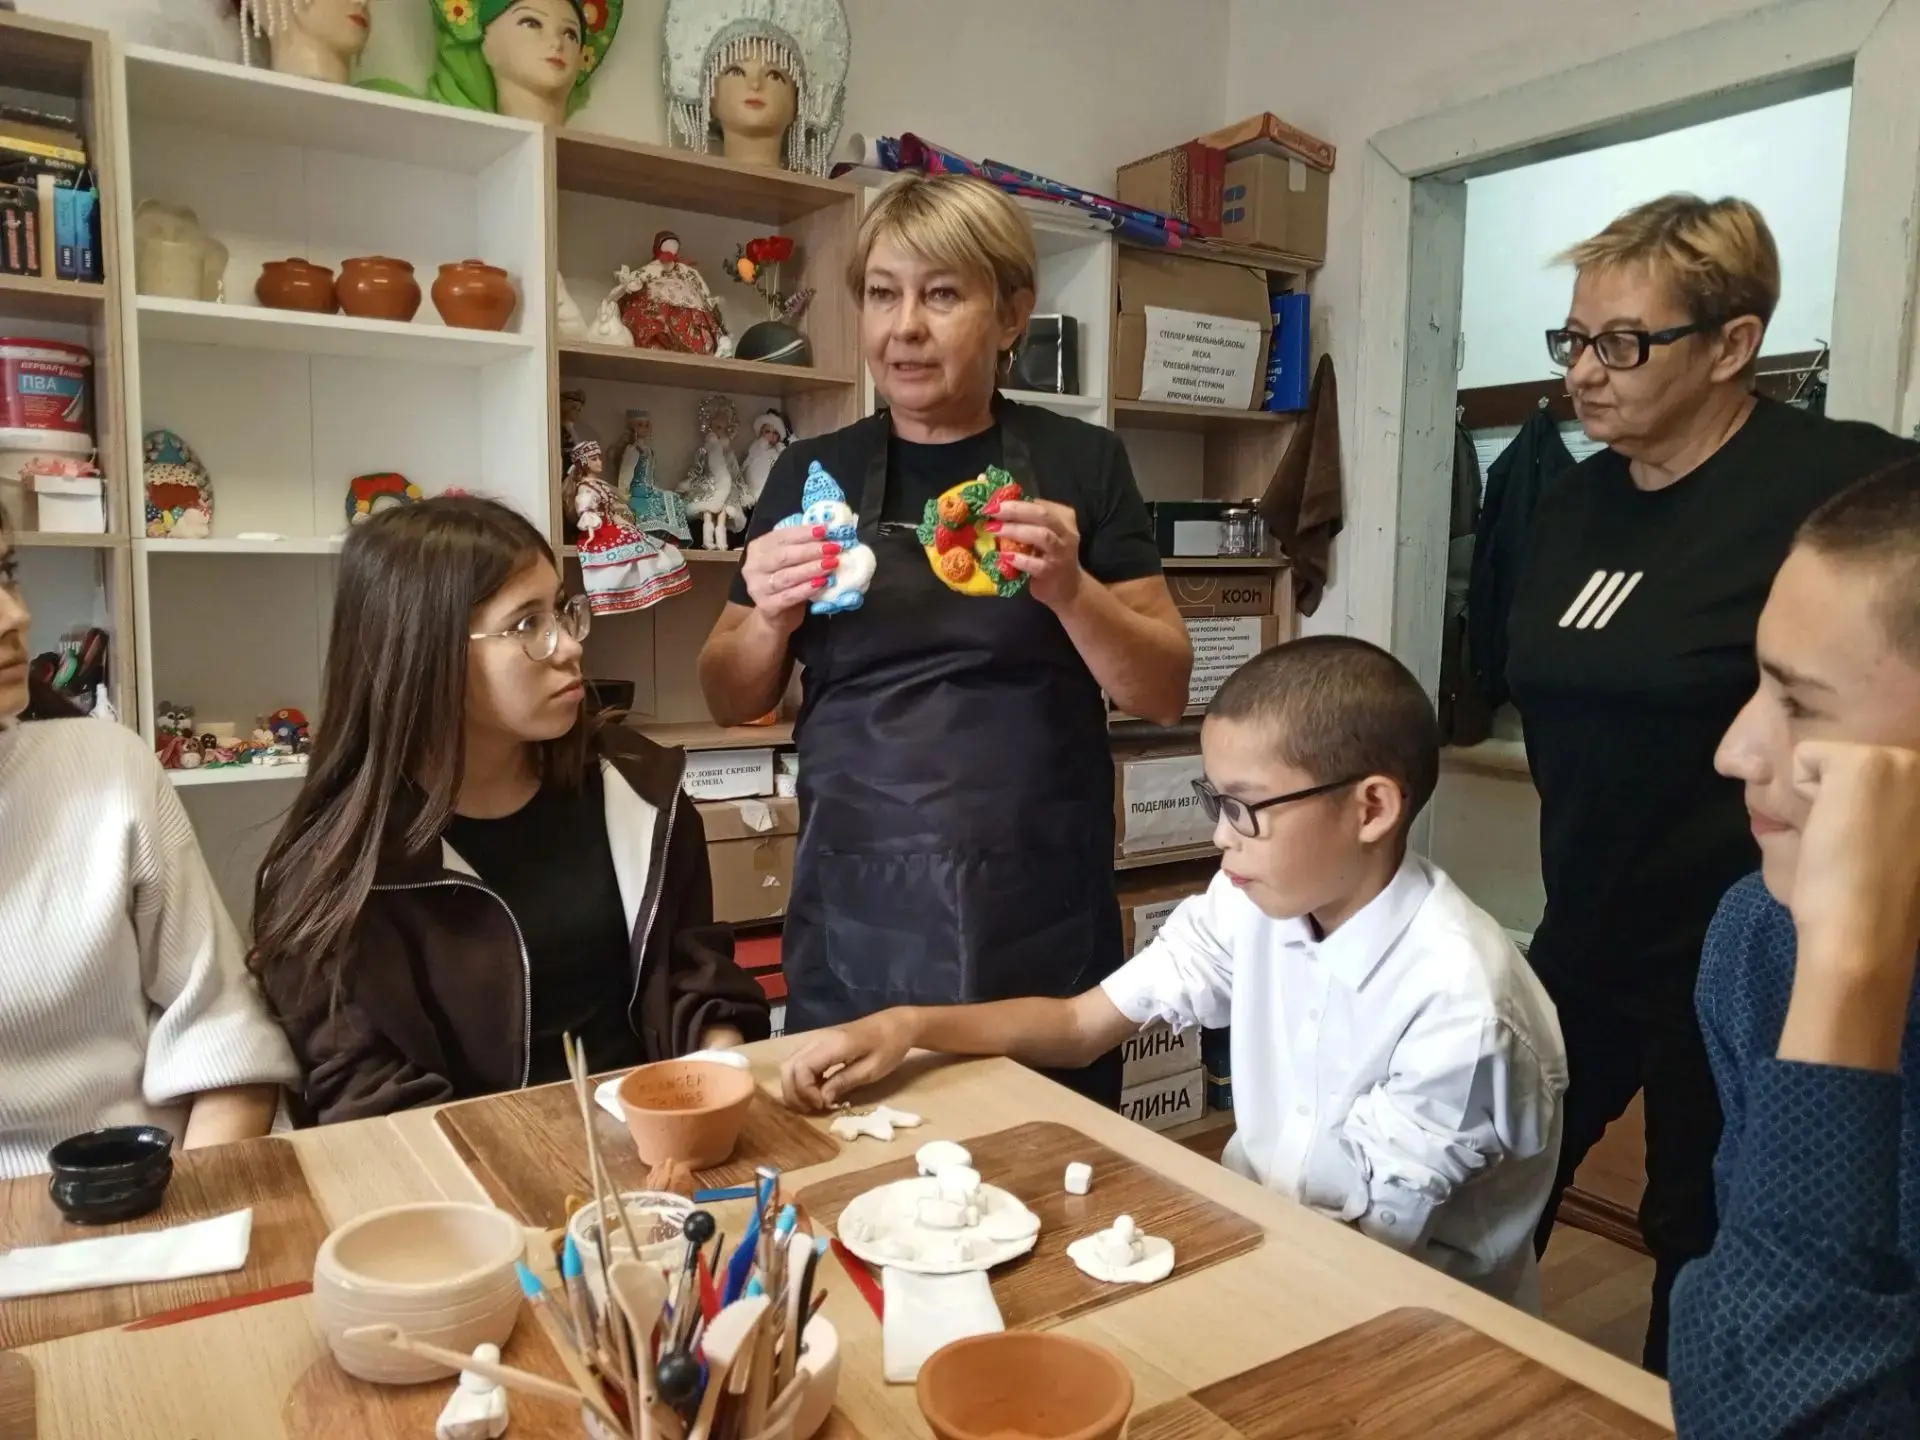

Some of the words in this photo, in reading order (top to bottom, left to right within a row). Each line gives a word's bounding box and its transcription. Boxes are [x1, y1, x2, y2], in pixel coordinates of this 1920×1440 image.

[1159, 330, 1186, 340] СТЕПЛЕР
[1192, 350, 1211, 359] ЛЕСКА
[1163, 360, 1190, 370] КЛЕЕВОЙ
[23, 375, 57, 391] ПВА
[726, 765, 761, 775] СКРЕПКИ
[691, 779, 724, 787] СЕМЕНА
[1131, 799, 1176, 814] ПОДЕЛКИ
[1177, 796, 1190, 808] ИЗ
[1121, 1030, 1185, 1064] ЛИНА
[1120, 1087, 1191, 1121] ГЛИНА
